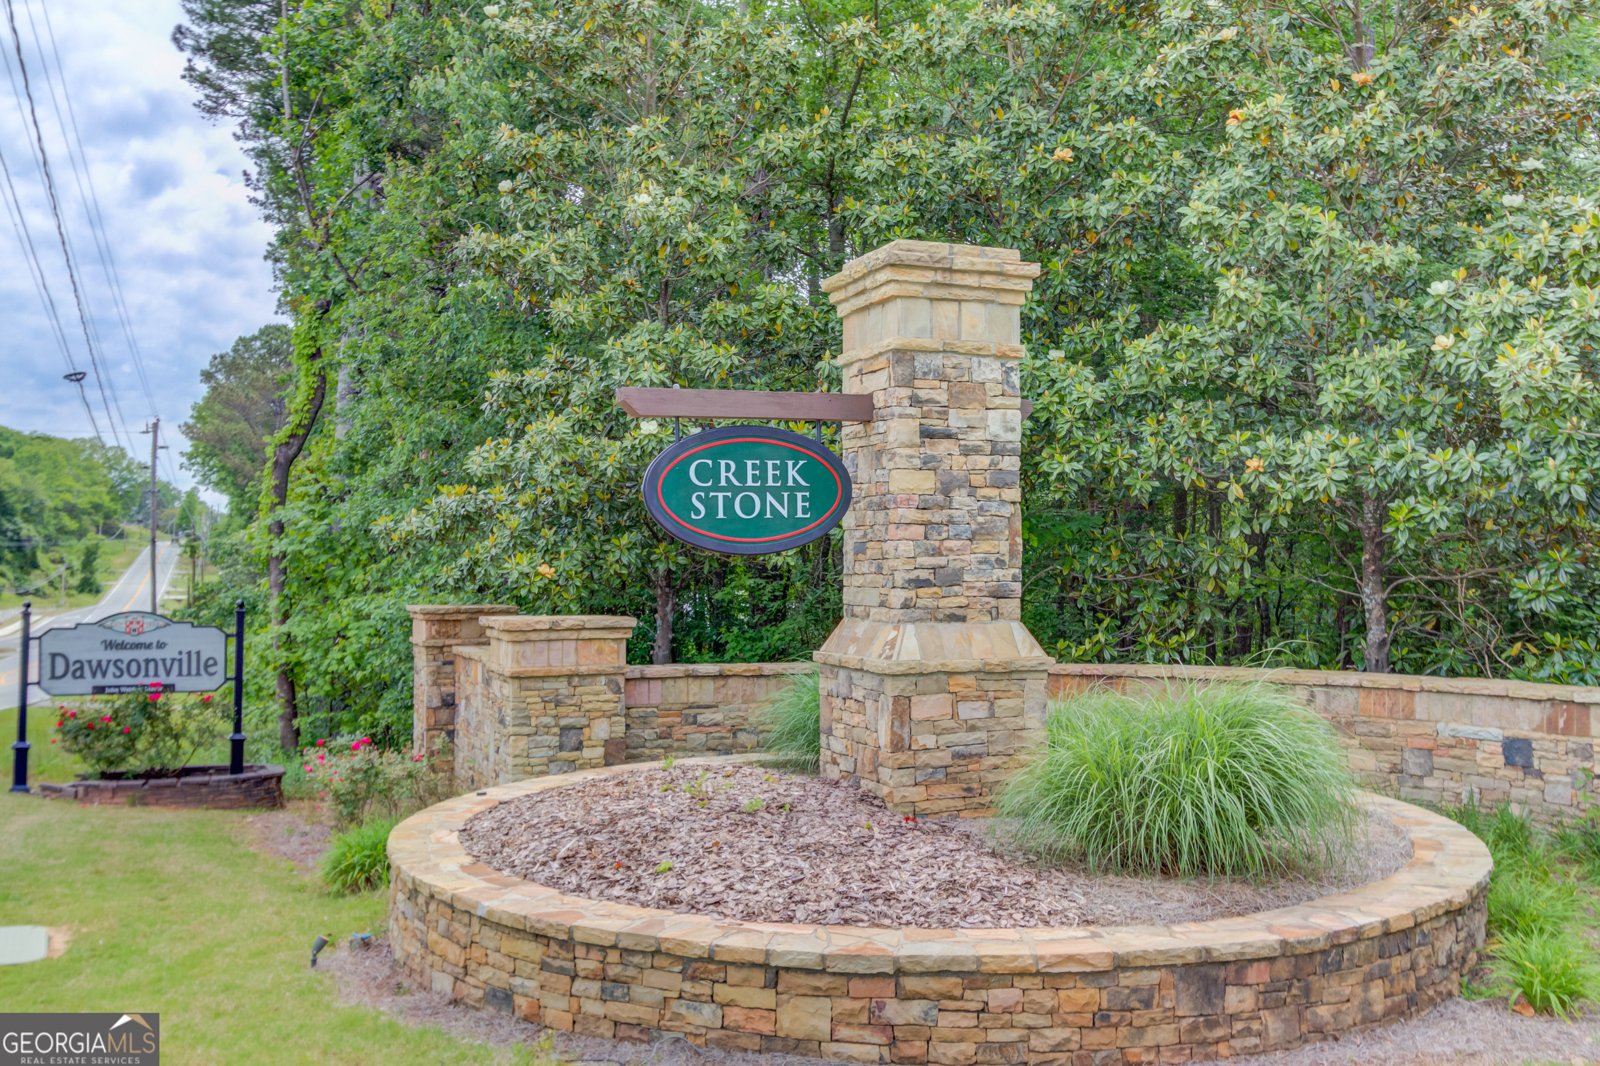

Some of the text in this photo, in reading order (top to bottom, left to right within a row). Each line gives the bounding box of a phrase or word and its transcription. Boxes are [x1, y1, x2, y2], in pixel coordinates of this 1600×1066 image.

[689, 459, 810, 487] CREEK
[691, 491, 811, 519] STONE
[101, 639, 169, 651] Welcome to
[48, 650, 218, 680] Dawsonville
